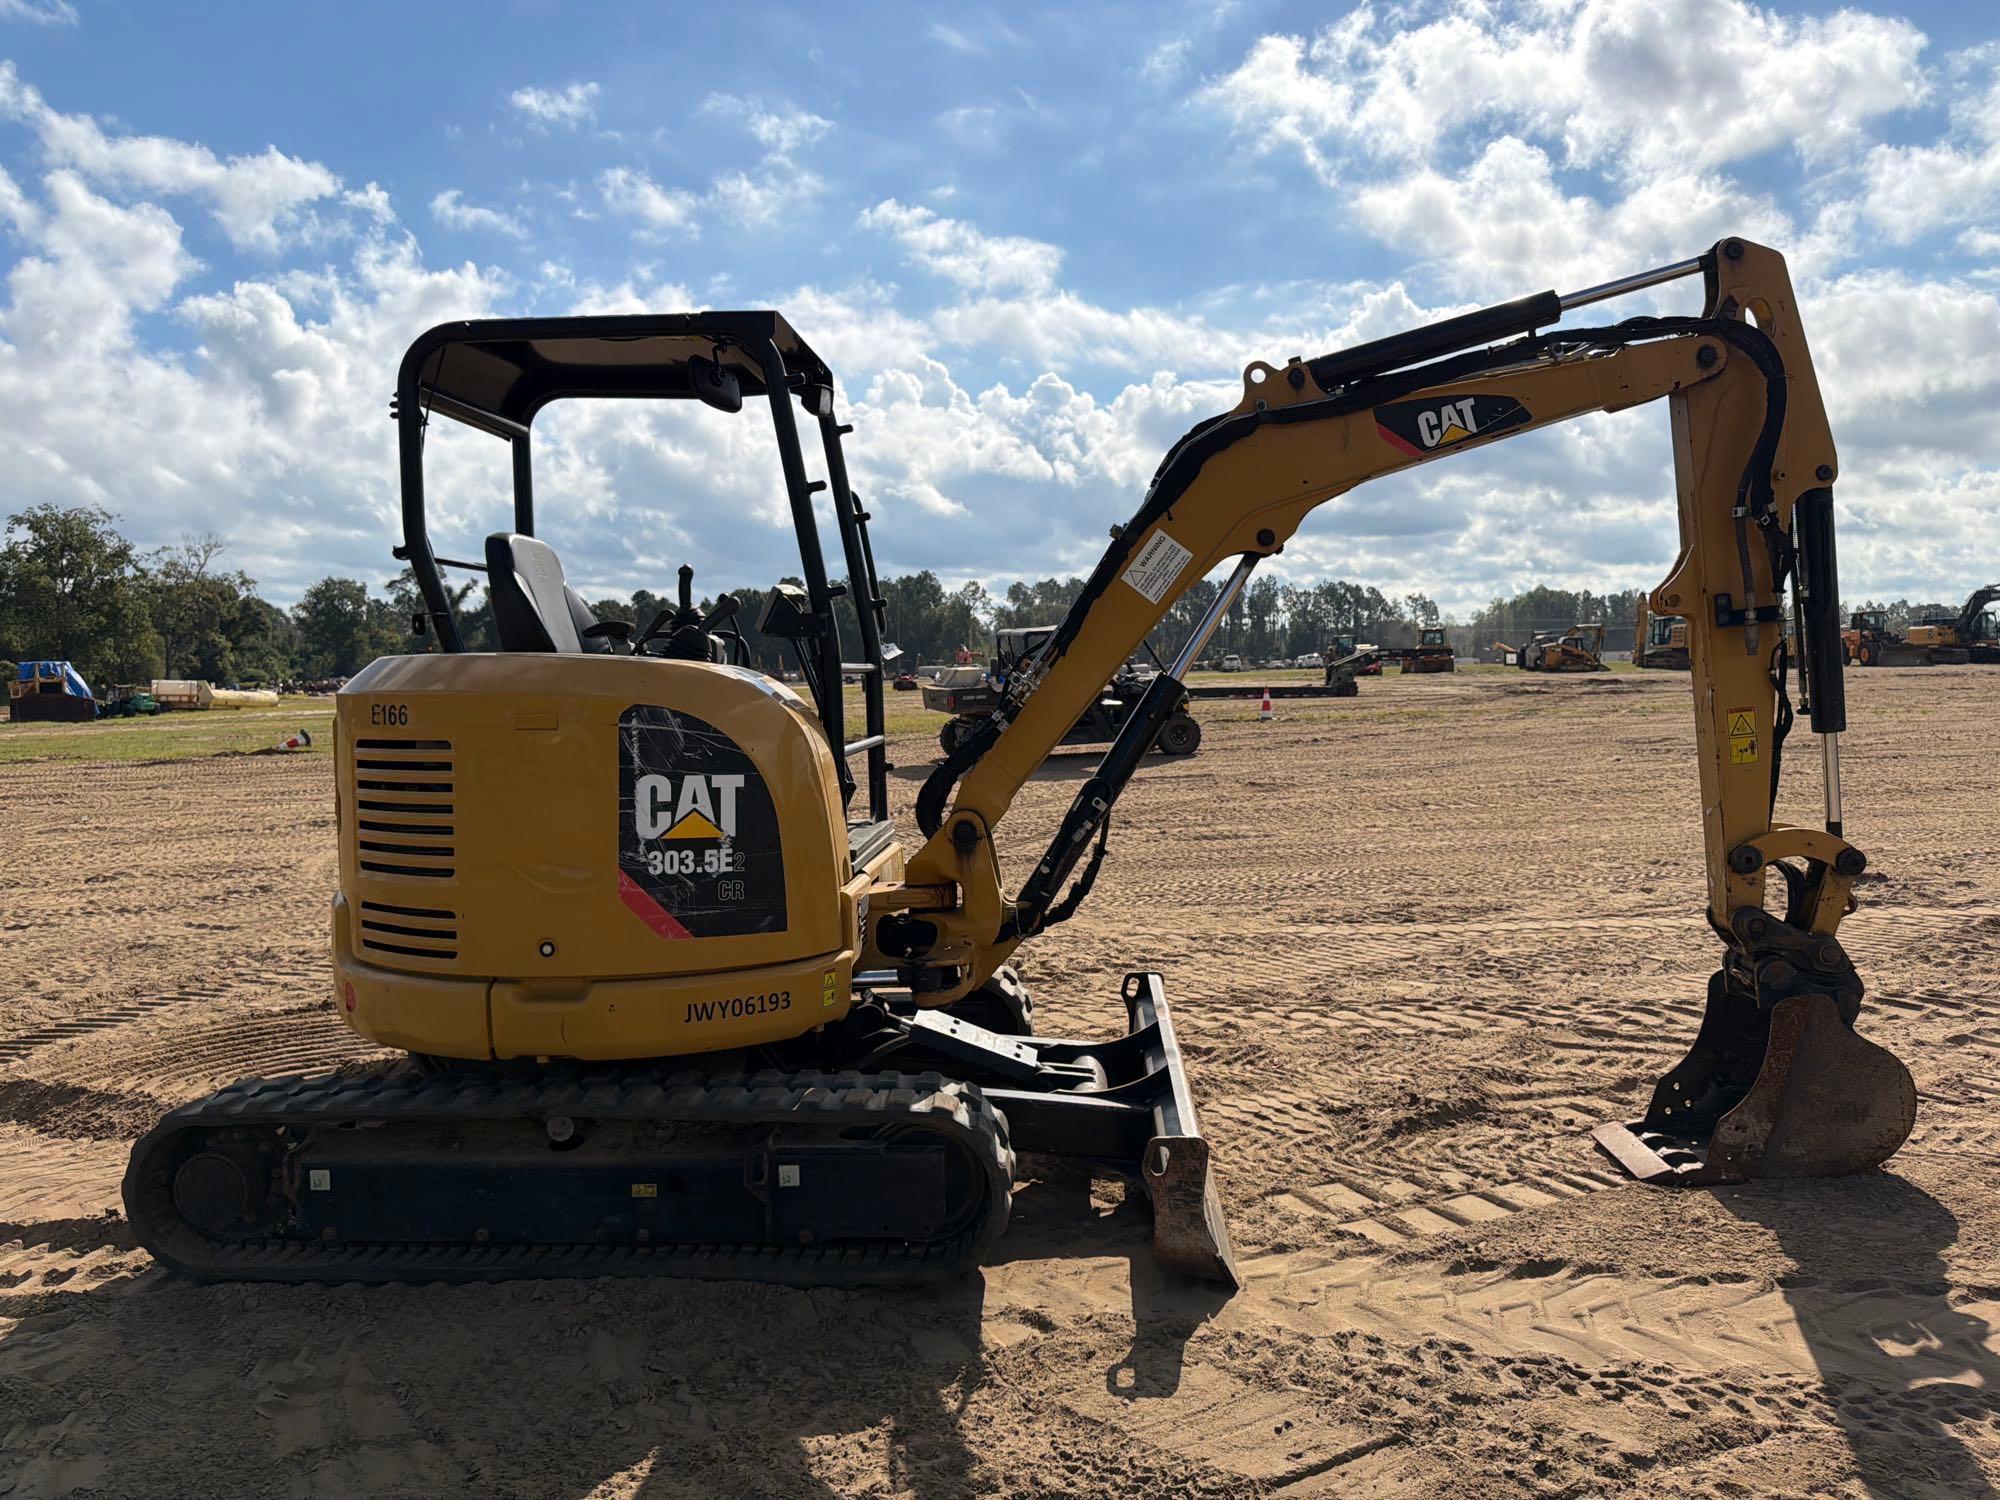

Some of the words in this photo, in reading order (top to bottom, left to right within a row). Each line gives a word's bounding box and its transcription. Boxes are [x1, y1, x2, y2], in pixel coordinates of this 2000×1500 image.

[1417, 397, 1478, 447] CAT
[1138, 535, 1167, 568] WARNING
[371, 703, 408, 726] E166
[635, 775, 745, 840] CAT
[648, 849, 746, 875] 303.5E2
[717, 880, 745, 901] CR
[684, 990, 791, 1024] JWY06193
